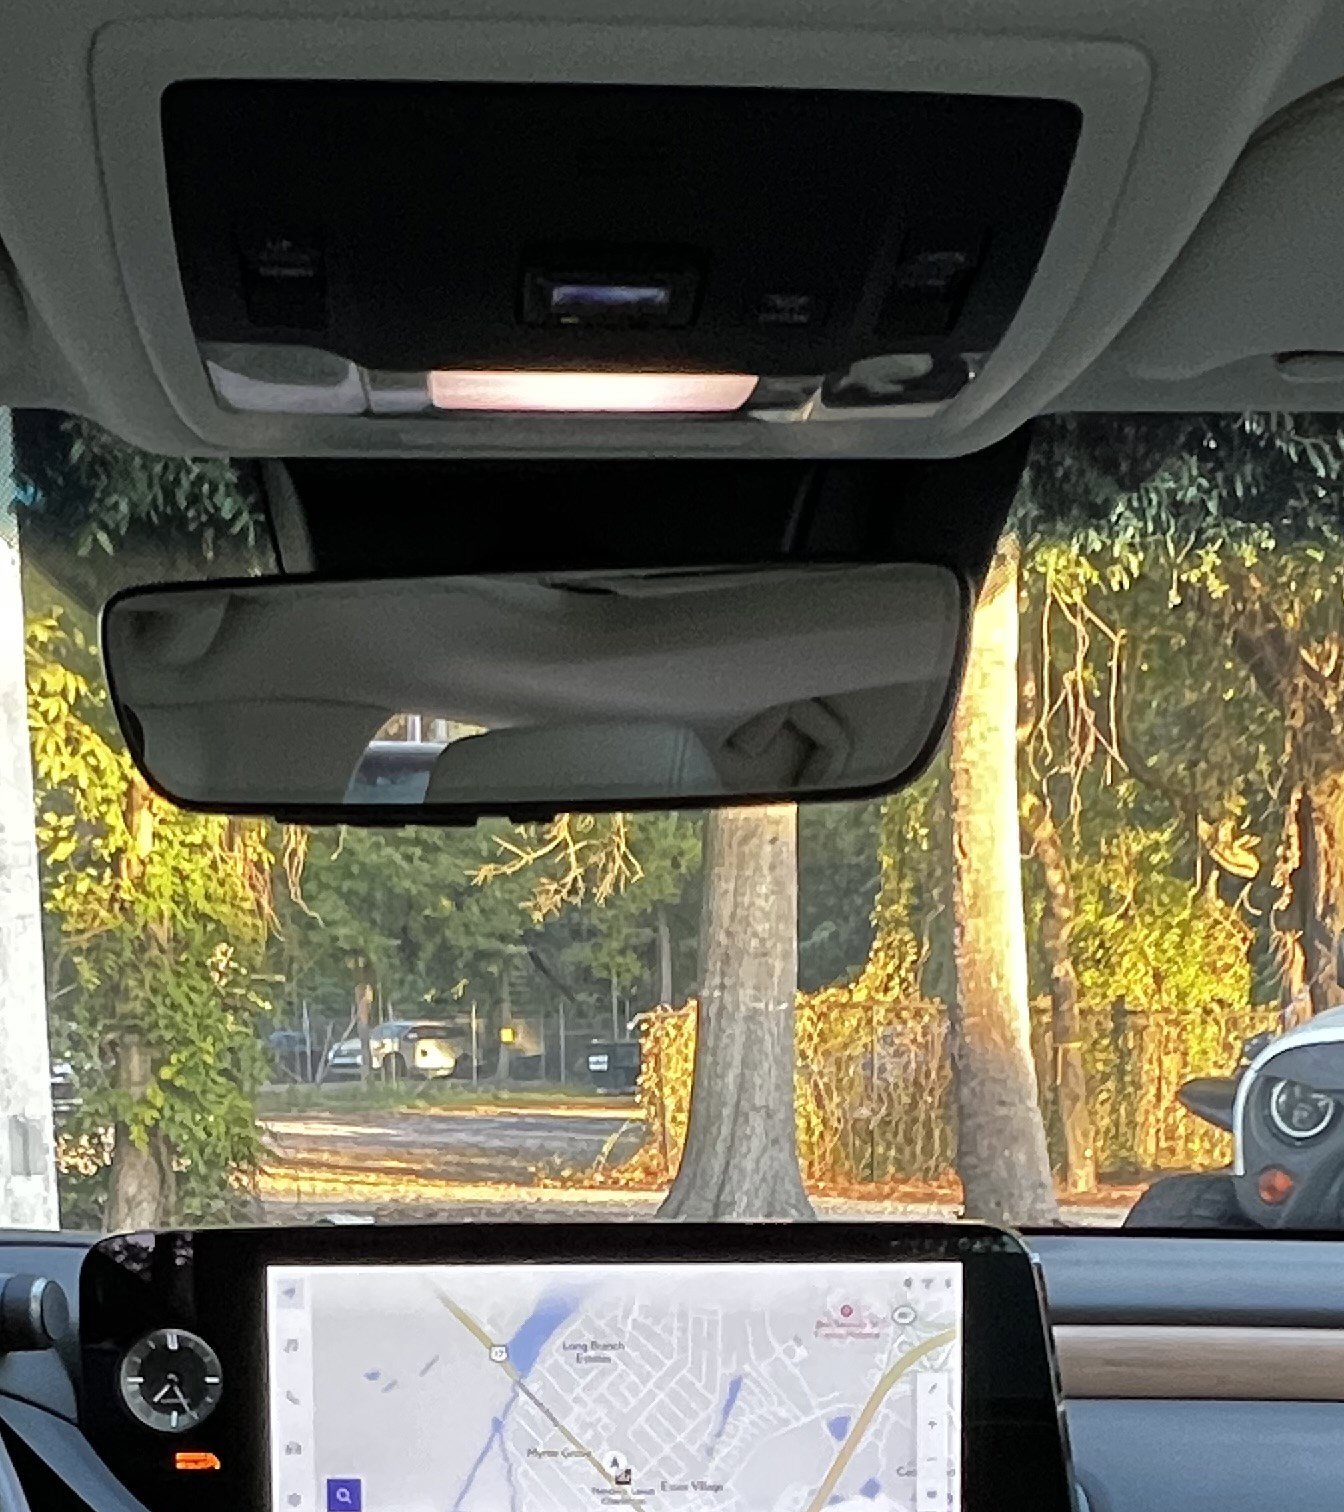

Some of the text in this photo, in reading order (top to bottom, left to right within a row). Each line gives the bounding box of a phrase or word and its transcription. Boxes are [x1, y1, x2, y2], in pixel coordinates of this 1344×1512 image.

[563, 1341, 625, 1352] Long Branch
[691, 1481, 723, 1493] Village
